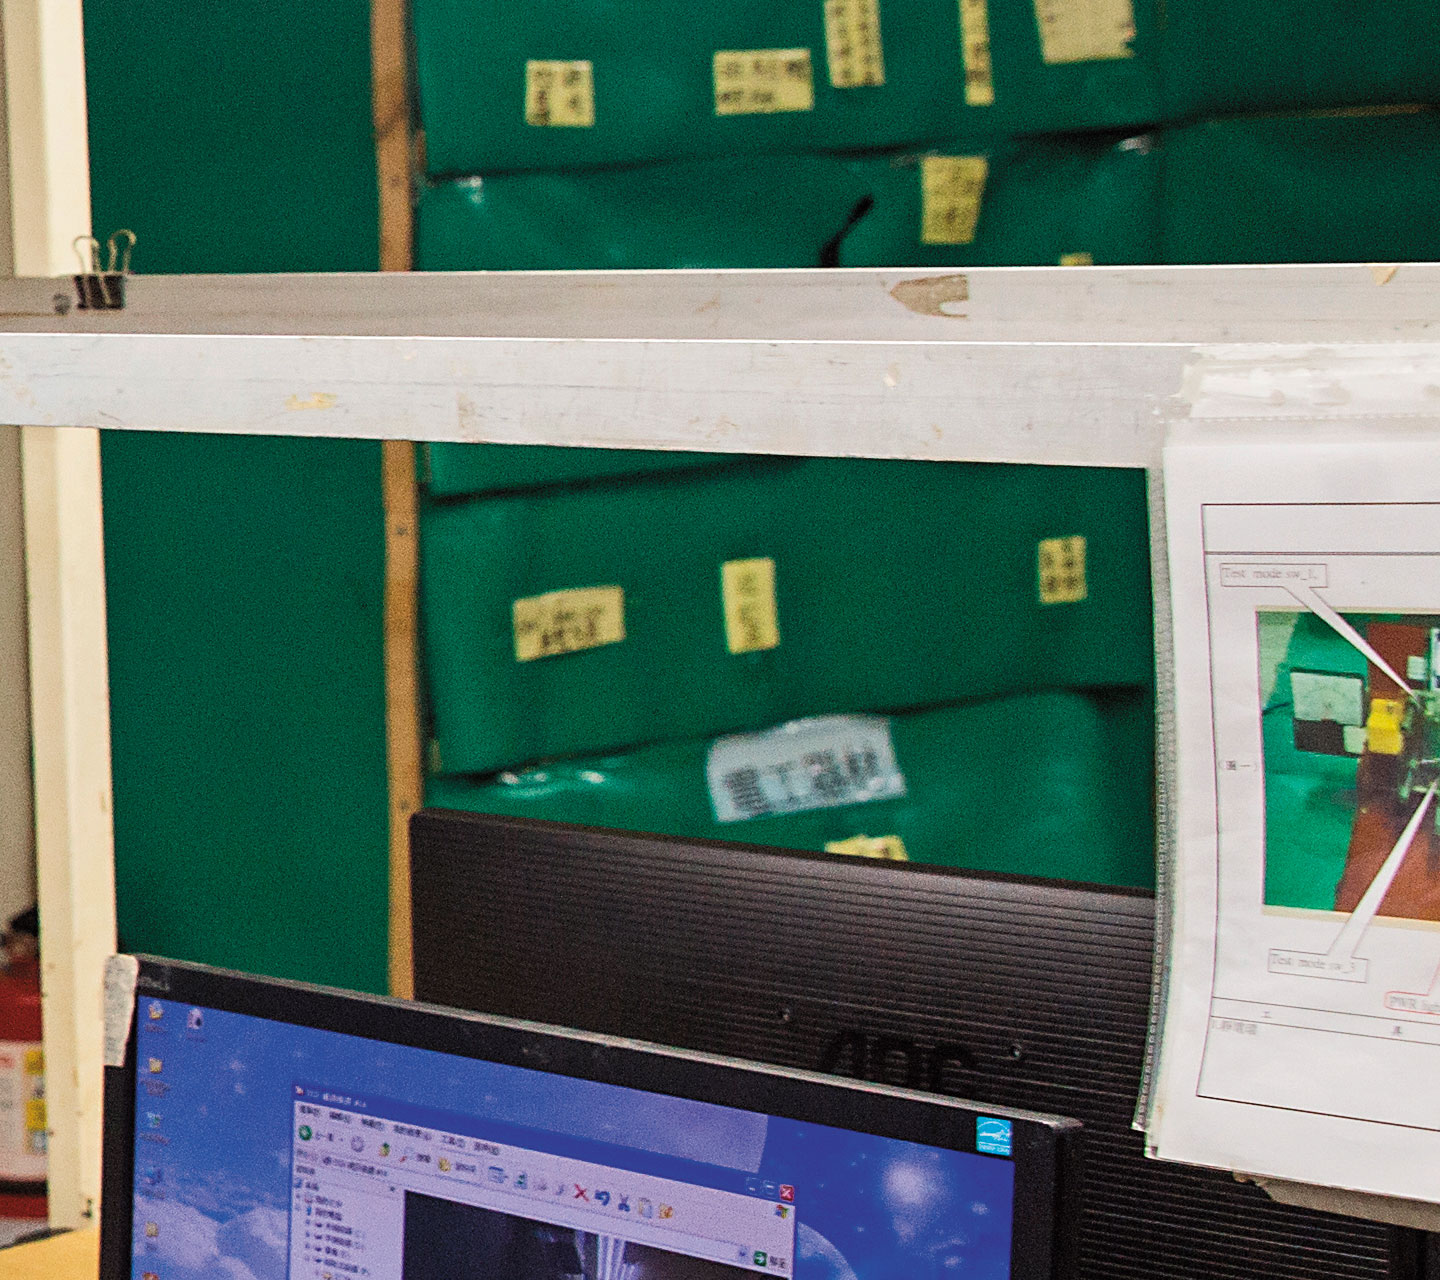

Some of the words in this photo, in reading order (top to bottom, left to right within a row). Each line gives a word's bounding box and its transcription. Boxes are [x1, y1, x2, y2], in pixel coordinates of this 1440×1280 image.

[1221, 567, 1247, 579] Test
[1253, 568, 1282, 580] mode
[1270, 953, 1294, 967] Test
[1298, 957, 1326, 971] mode
[1389, 995, 1418, 1010] PWR
